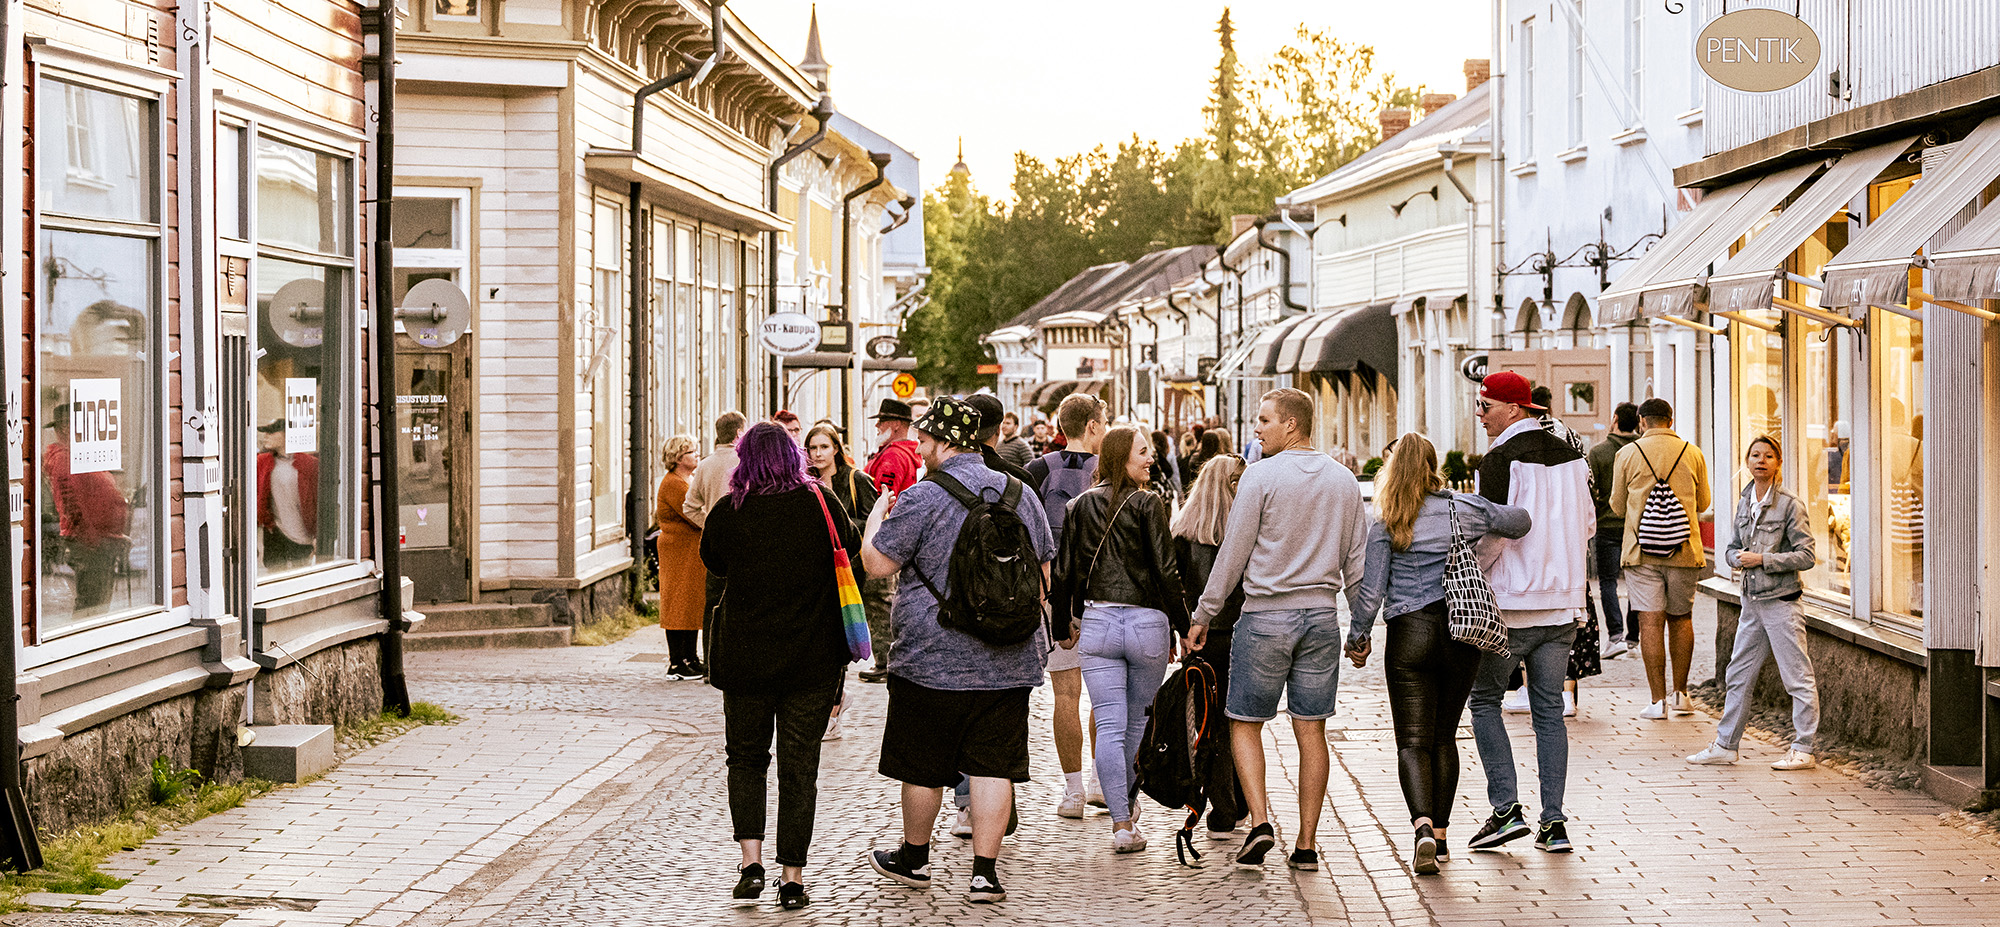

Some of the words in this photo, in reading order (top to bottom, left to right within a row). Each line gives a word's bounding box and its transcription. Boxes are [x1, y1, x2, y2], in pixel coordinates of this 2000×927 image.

[1706, 37, 1804, 63] PENTIK
[1468, 360, 1489, 376] Ca
[288, 386, 314, 428] tinos
[430, 395, 448, 403] IDEA
[74, 389, 118, 443] tinos
